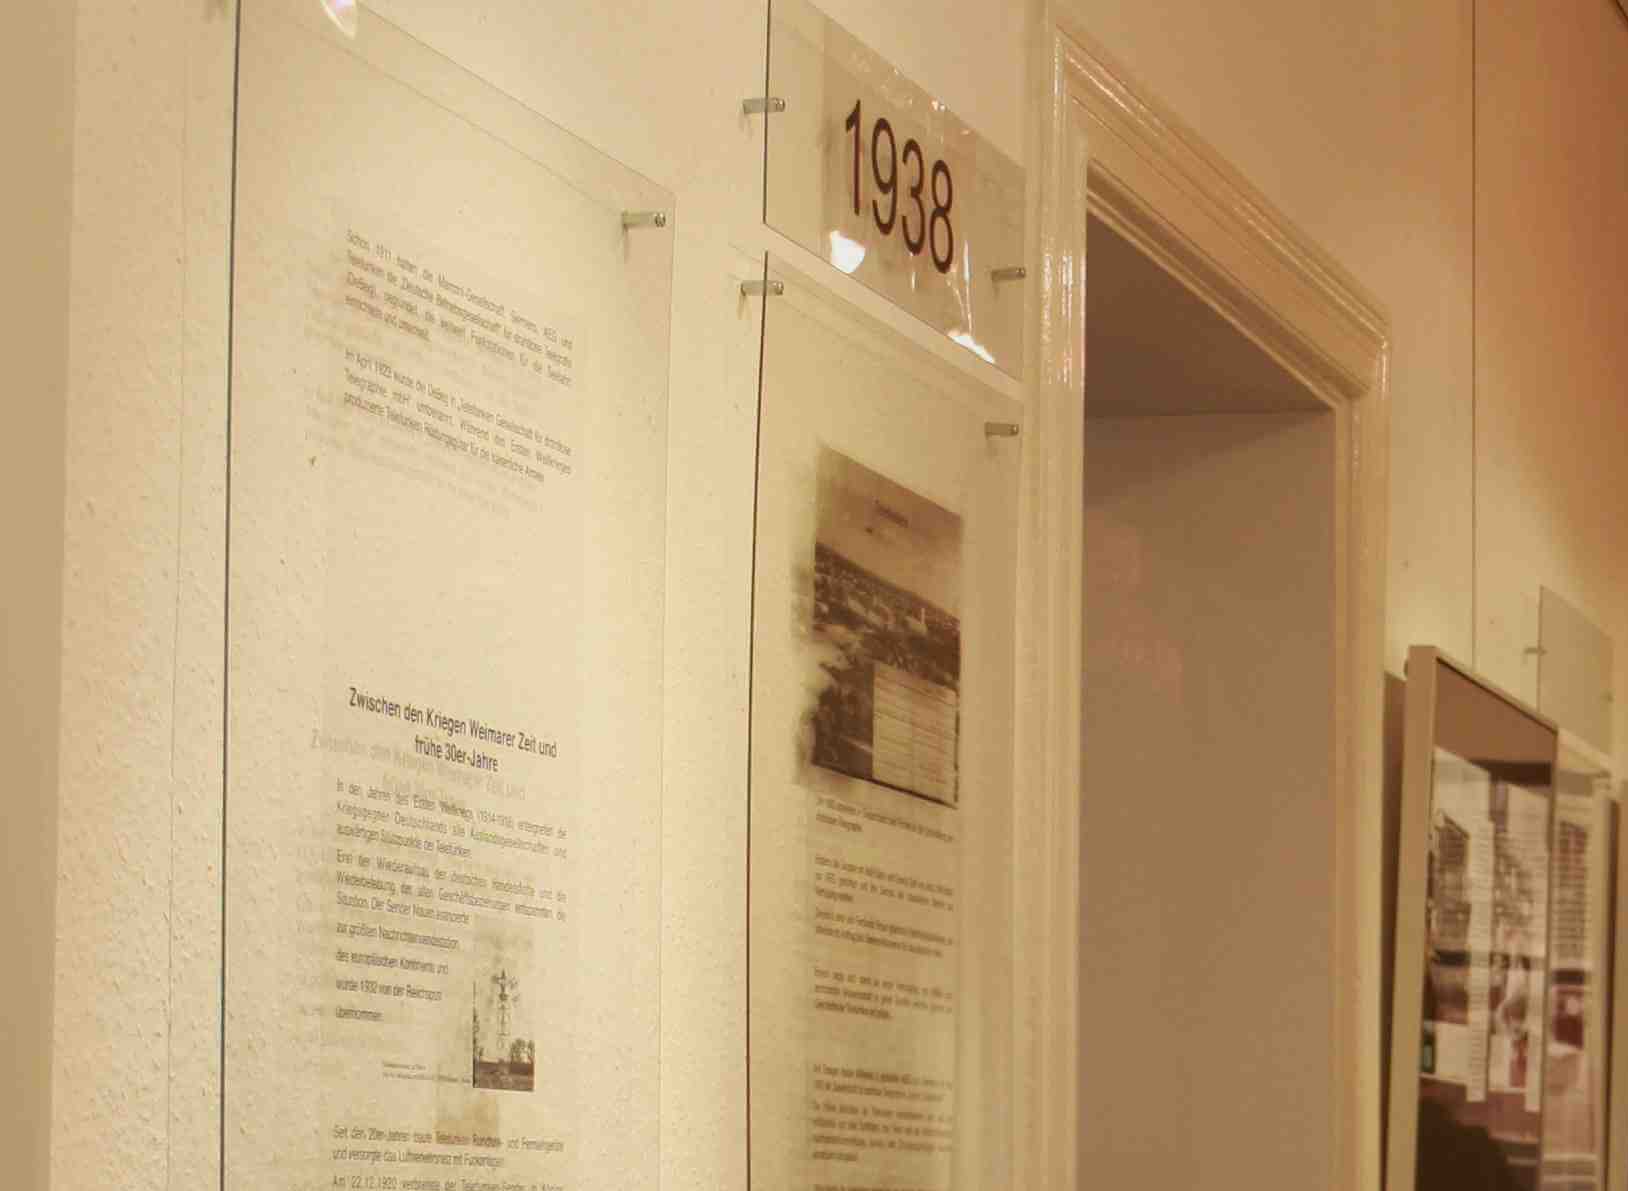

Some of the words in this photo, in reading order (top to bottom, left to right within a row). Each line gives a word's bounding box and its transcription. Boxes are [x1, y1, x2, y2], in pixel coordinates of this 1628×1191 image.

[845, 99, 954, 274] 1938
[348, 686, 402, 720] Zwischen
[403, 703, 424, 726] den
[426, 706, 468, 738] Kriegen
[469, 718, 517, 750] Weimarer
[518, 730, 537, 755] Zeit
[539, 737, 558, 759] und
[414, 736, 443, 761] frühe
[444, 742, 499, 774] 30er-Jahre
